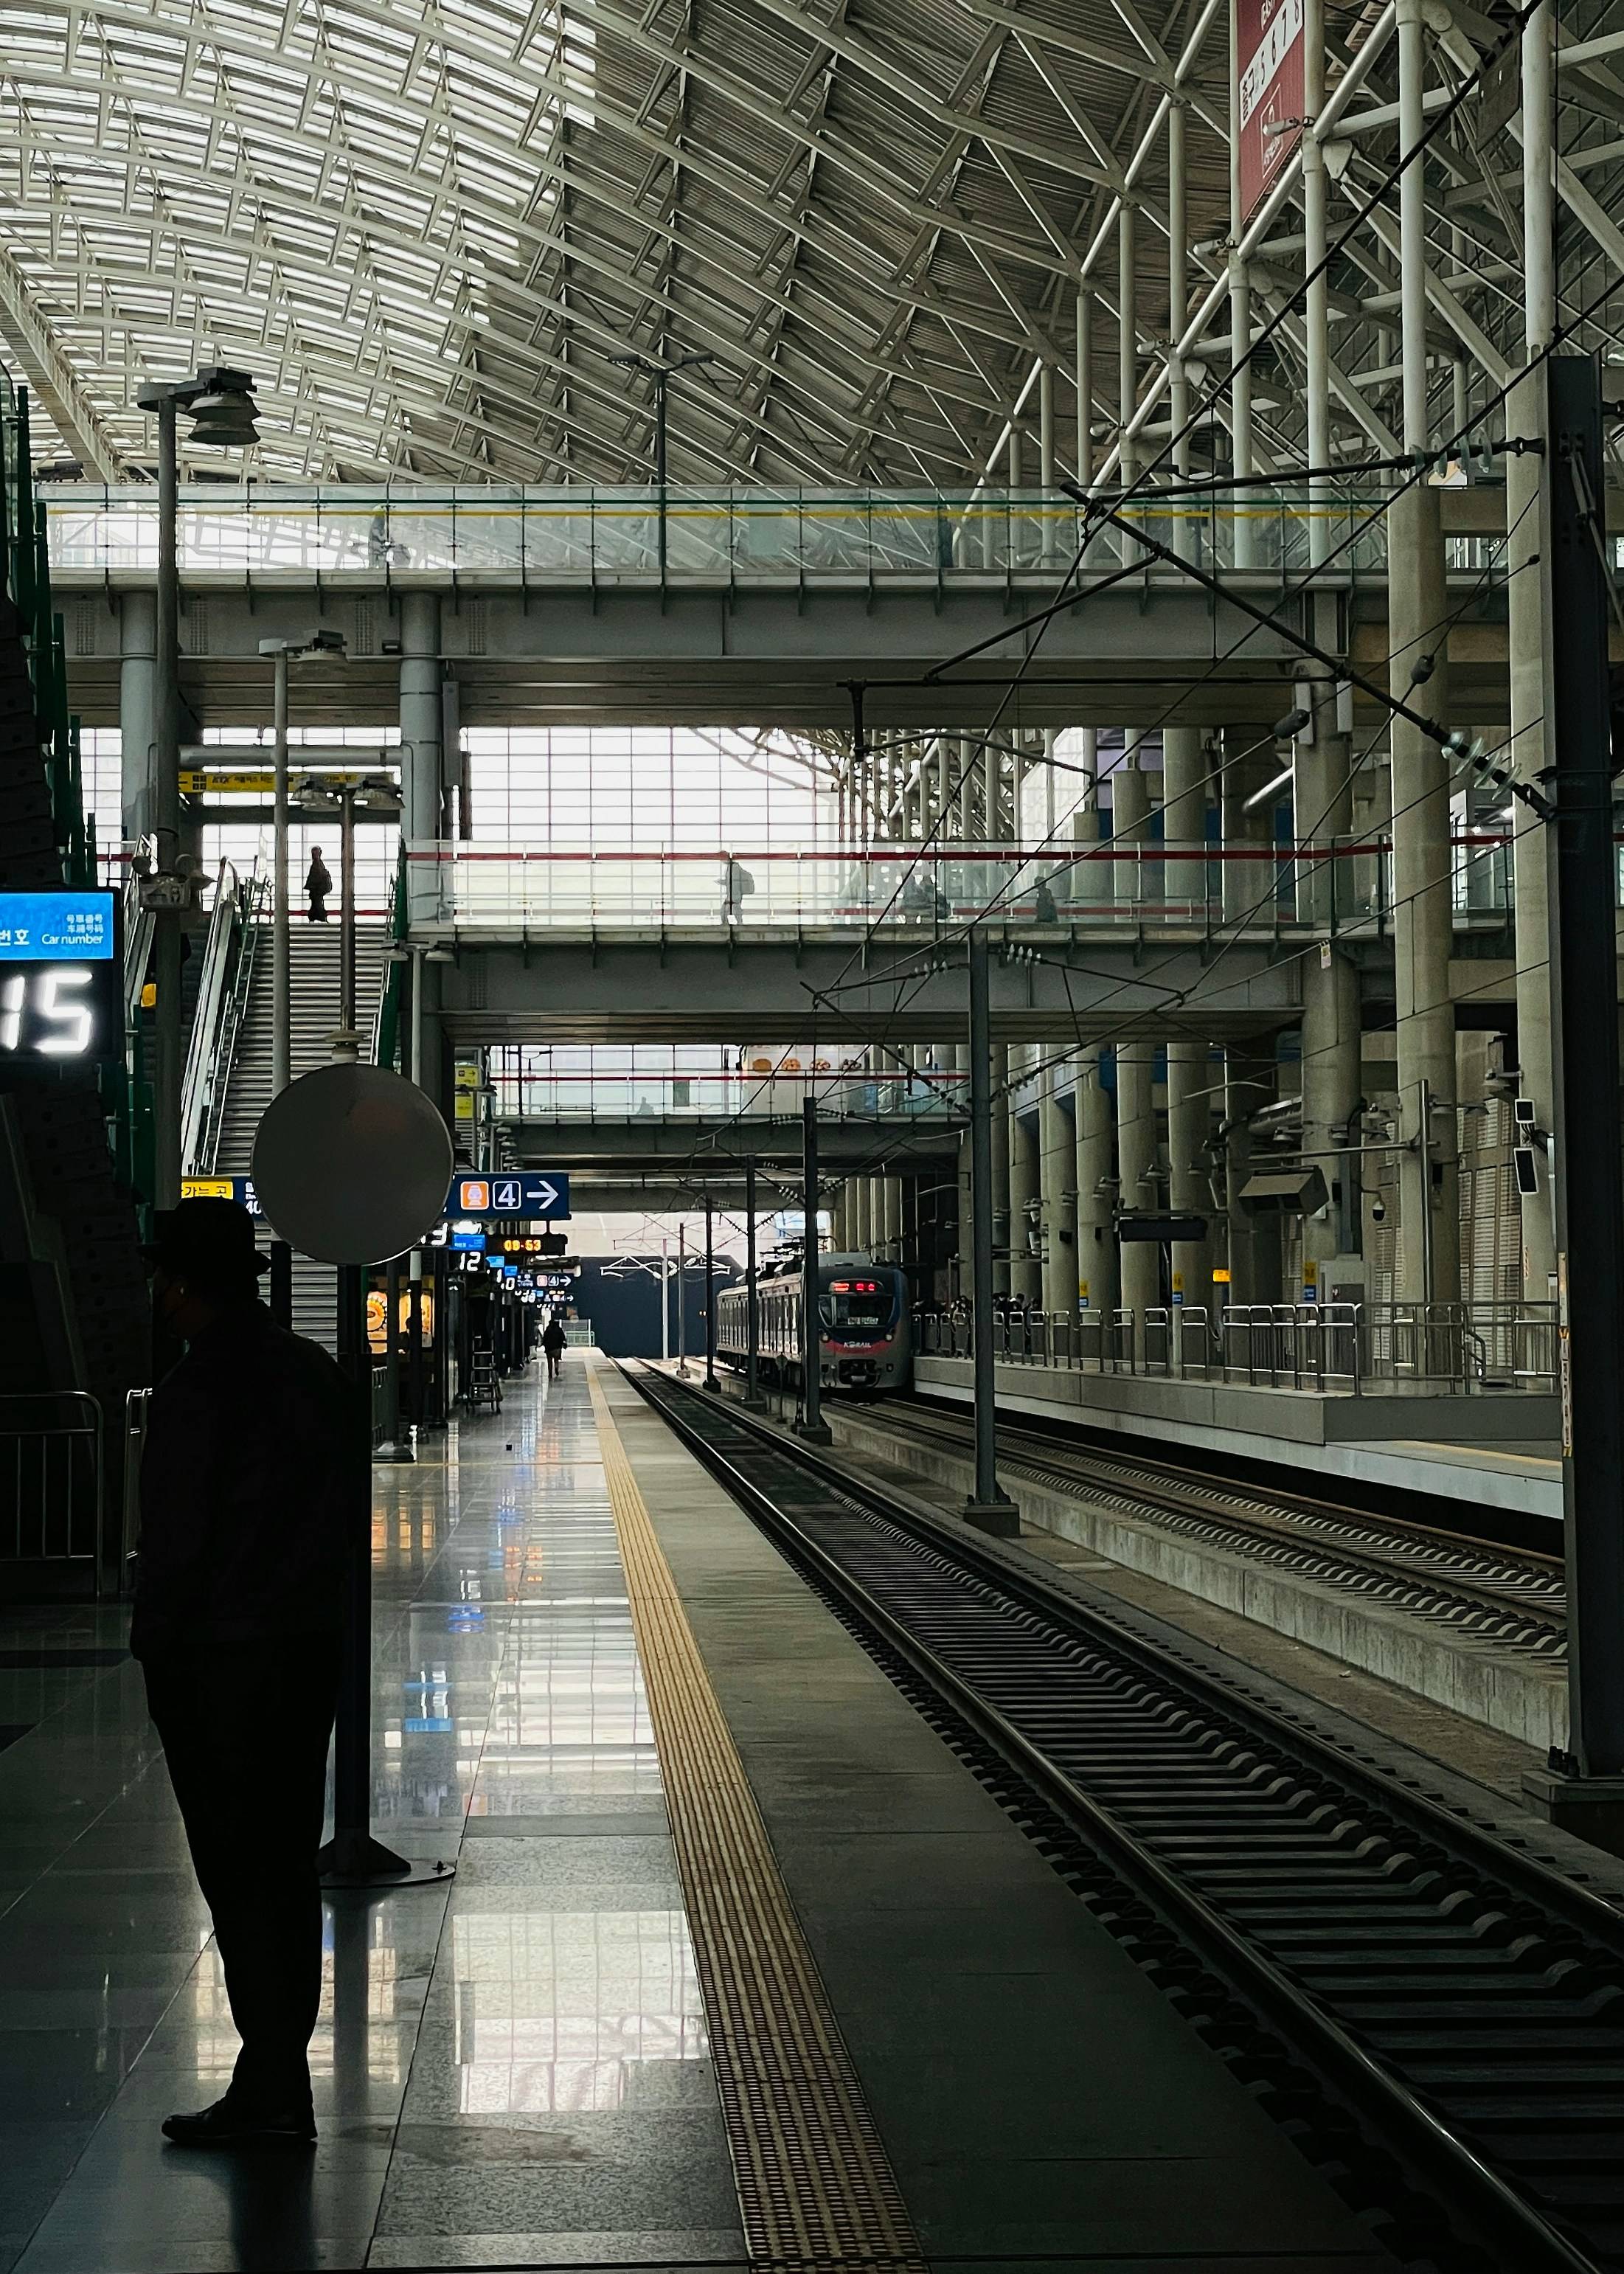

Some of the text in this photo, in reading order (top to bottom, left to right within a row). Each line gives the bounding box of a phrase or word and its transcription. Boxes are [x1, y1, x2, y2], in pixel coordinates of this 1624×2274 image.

[41, 933, 103, 945] Car number
[2, 971, 94, 1053] 15
[181, 1187, 209, 1196] 가는
[498, 1183, 516, 1206] 4
[459, 1251, 481, 1272] 12
